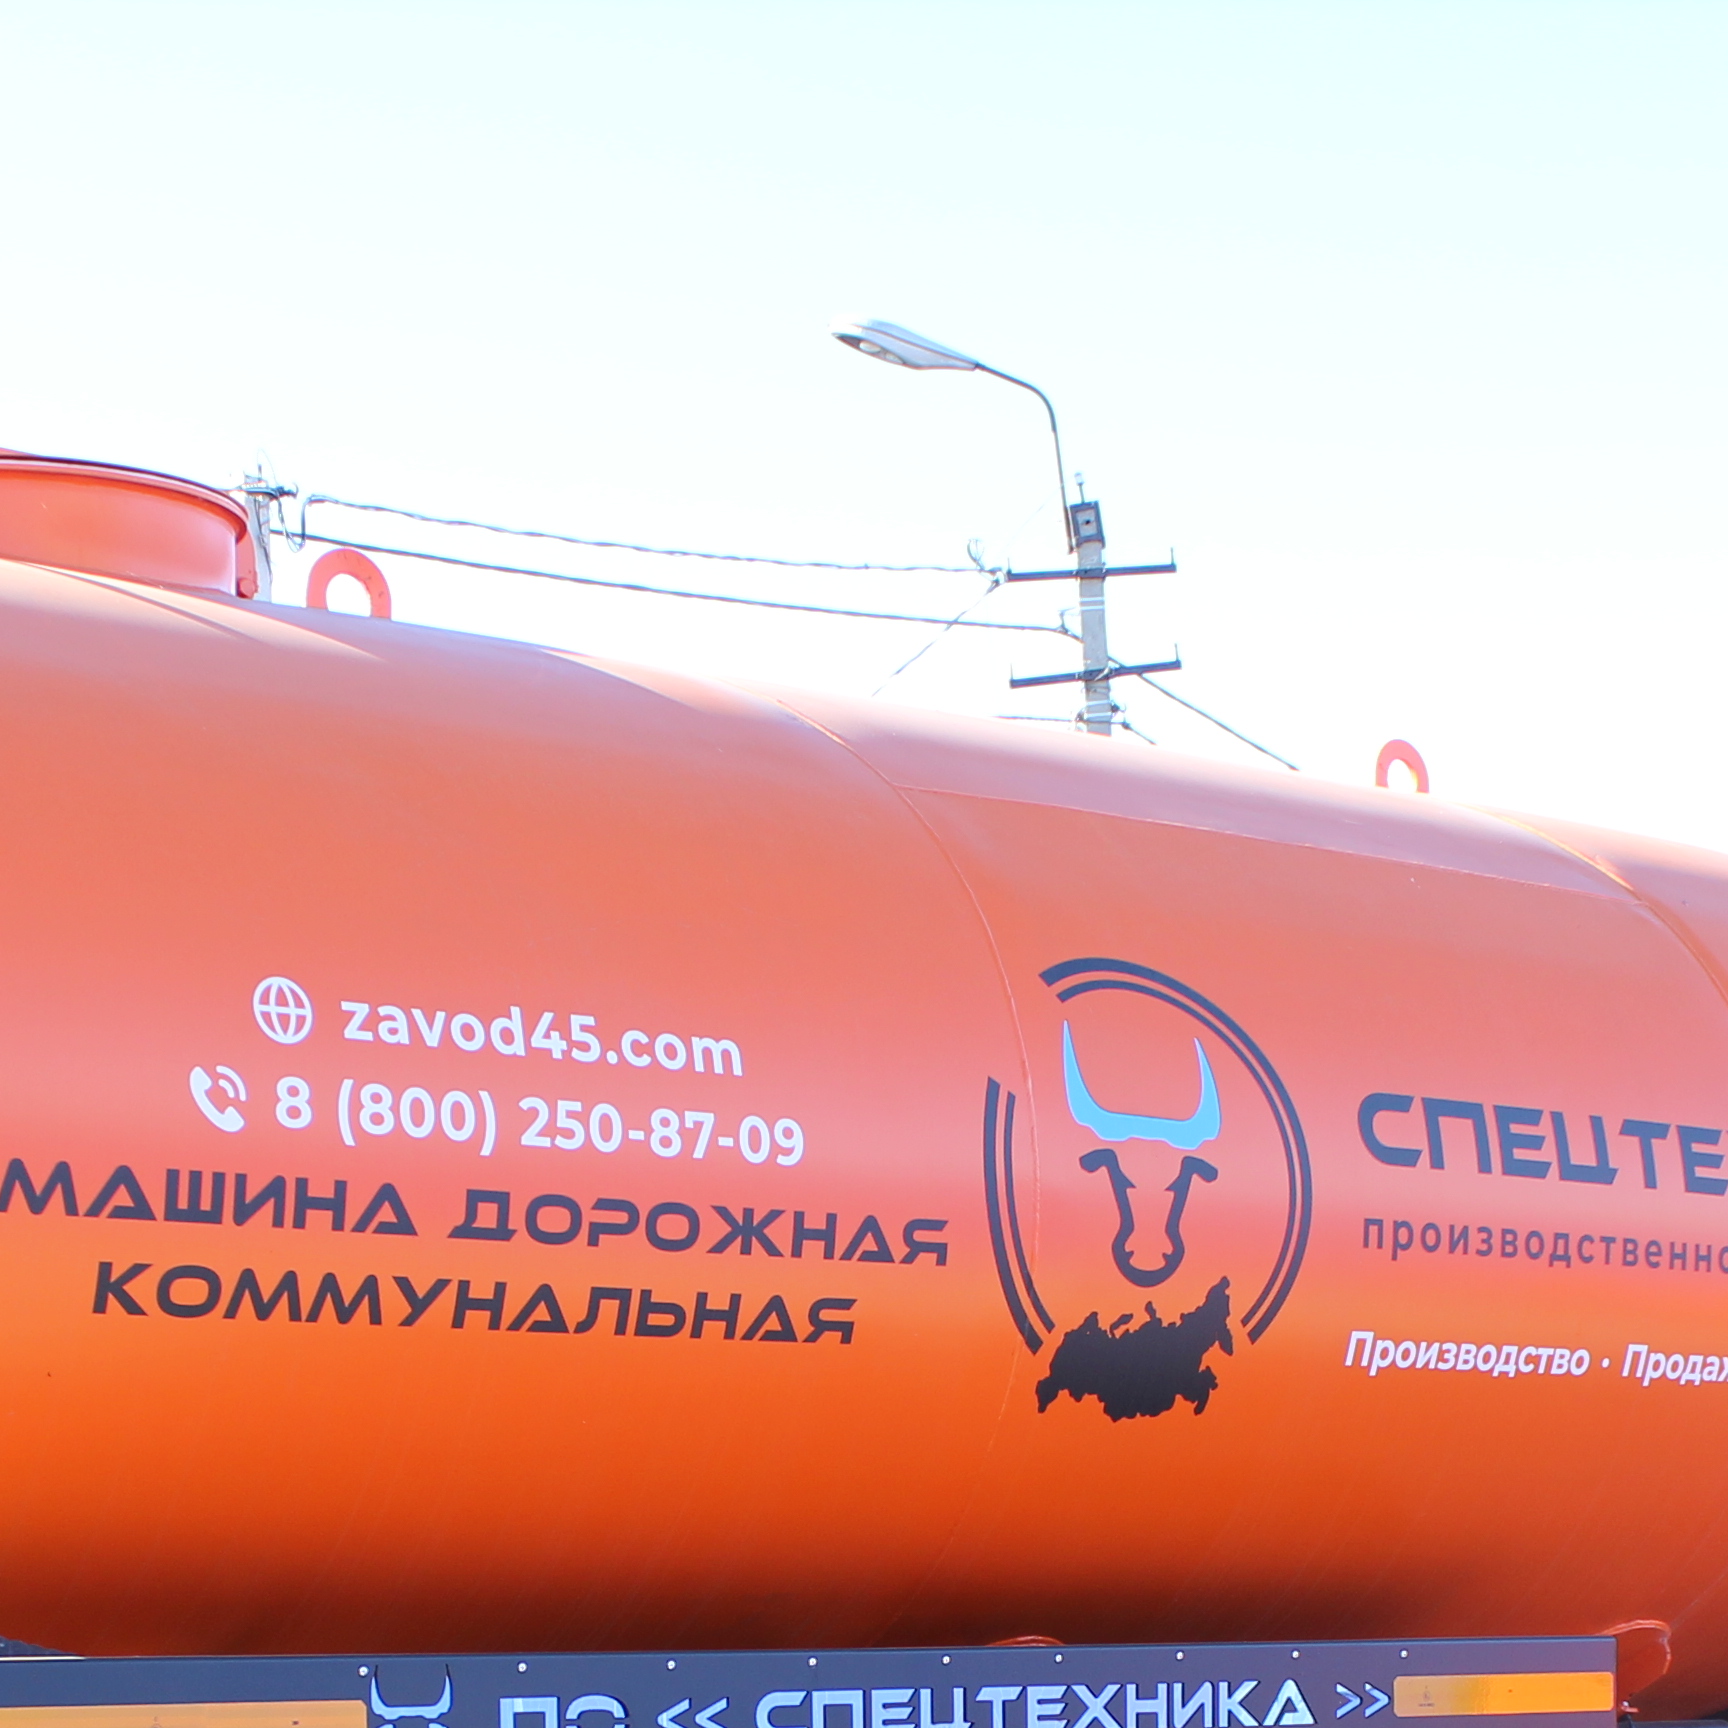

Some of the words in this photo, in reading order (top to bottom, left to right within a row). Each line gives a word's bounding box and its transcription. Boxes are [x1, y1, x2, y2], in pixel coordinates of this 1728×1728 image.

[340, 1000, 743, 1077] zavod45.com
[275, 1076, 313, 1129] 8
[338, 1078, 496, 1156] (800)
[518, 1096, 804, 1166] 250-87-09
[447, 1188, 949, 1266] ДОРОЖНАЯ
[92, 1261, 858, 1345] КОММУНАЛЬНАЯ
[1345, 1330, 1590, 1378] Производство
